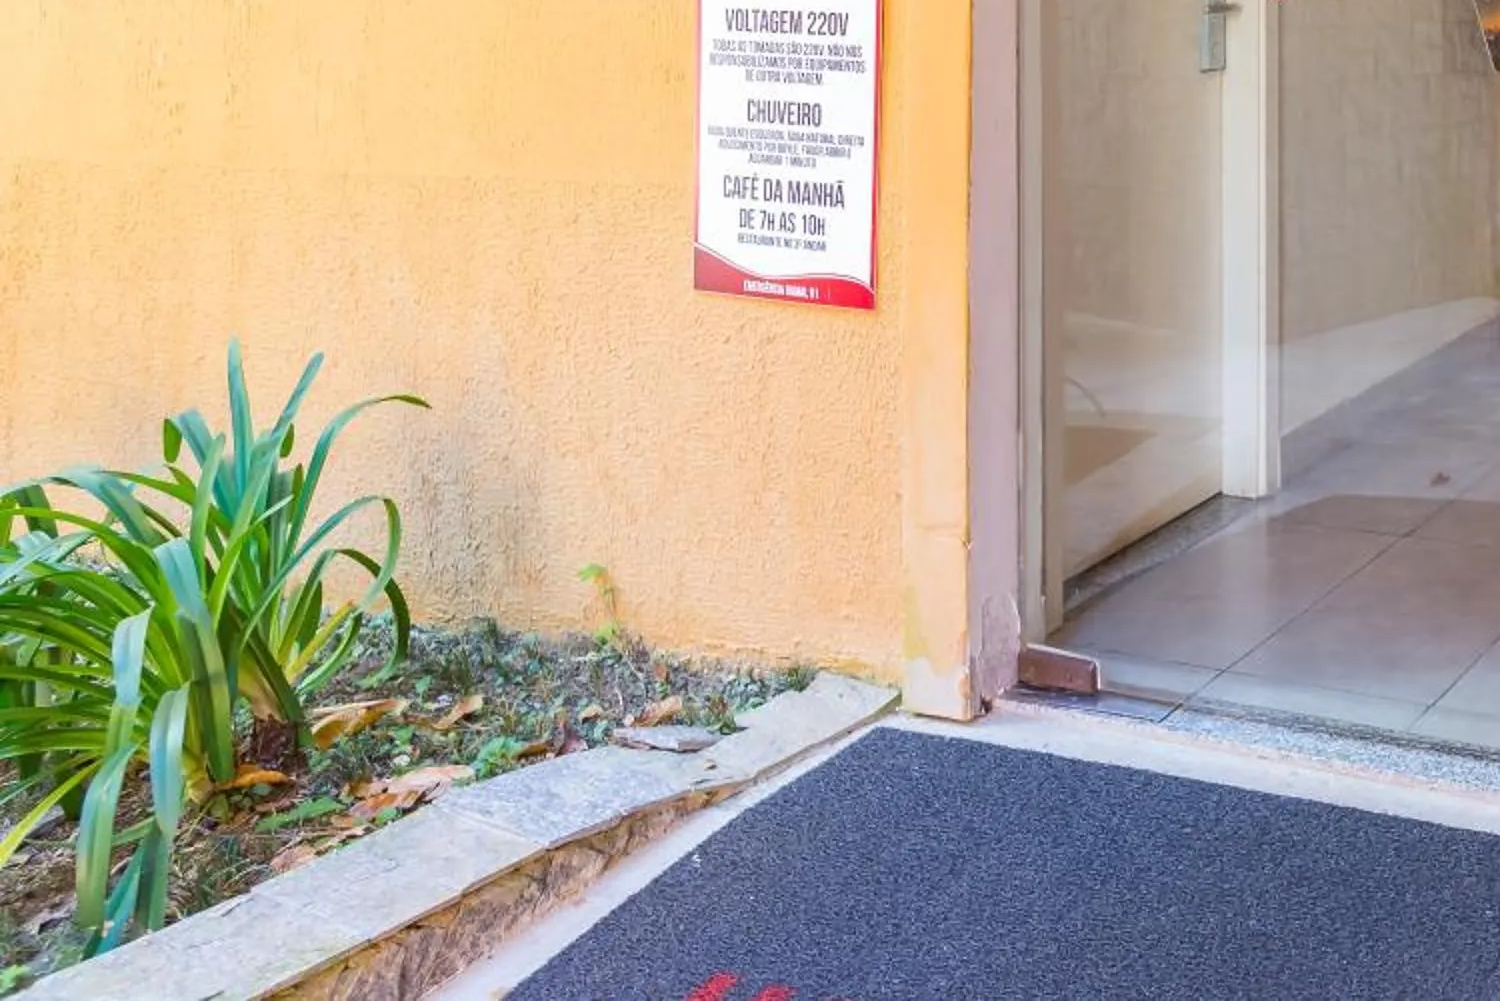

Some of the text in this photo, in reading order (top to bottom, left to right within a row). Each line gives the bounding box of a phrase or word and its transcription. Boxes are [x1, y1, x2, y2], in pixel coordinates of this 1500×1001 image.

[725, 8, 849, 36] VOLTAGEM 220V
[747, 99, 822, 128] CHUVEIRO
[723, 172, 845, 209] CAFÉ DA MANHÃ
[739, 208, 755, 230] DE
[760, 210, 775, 232] 7H
[802, 214, 826, 237] 10H
